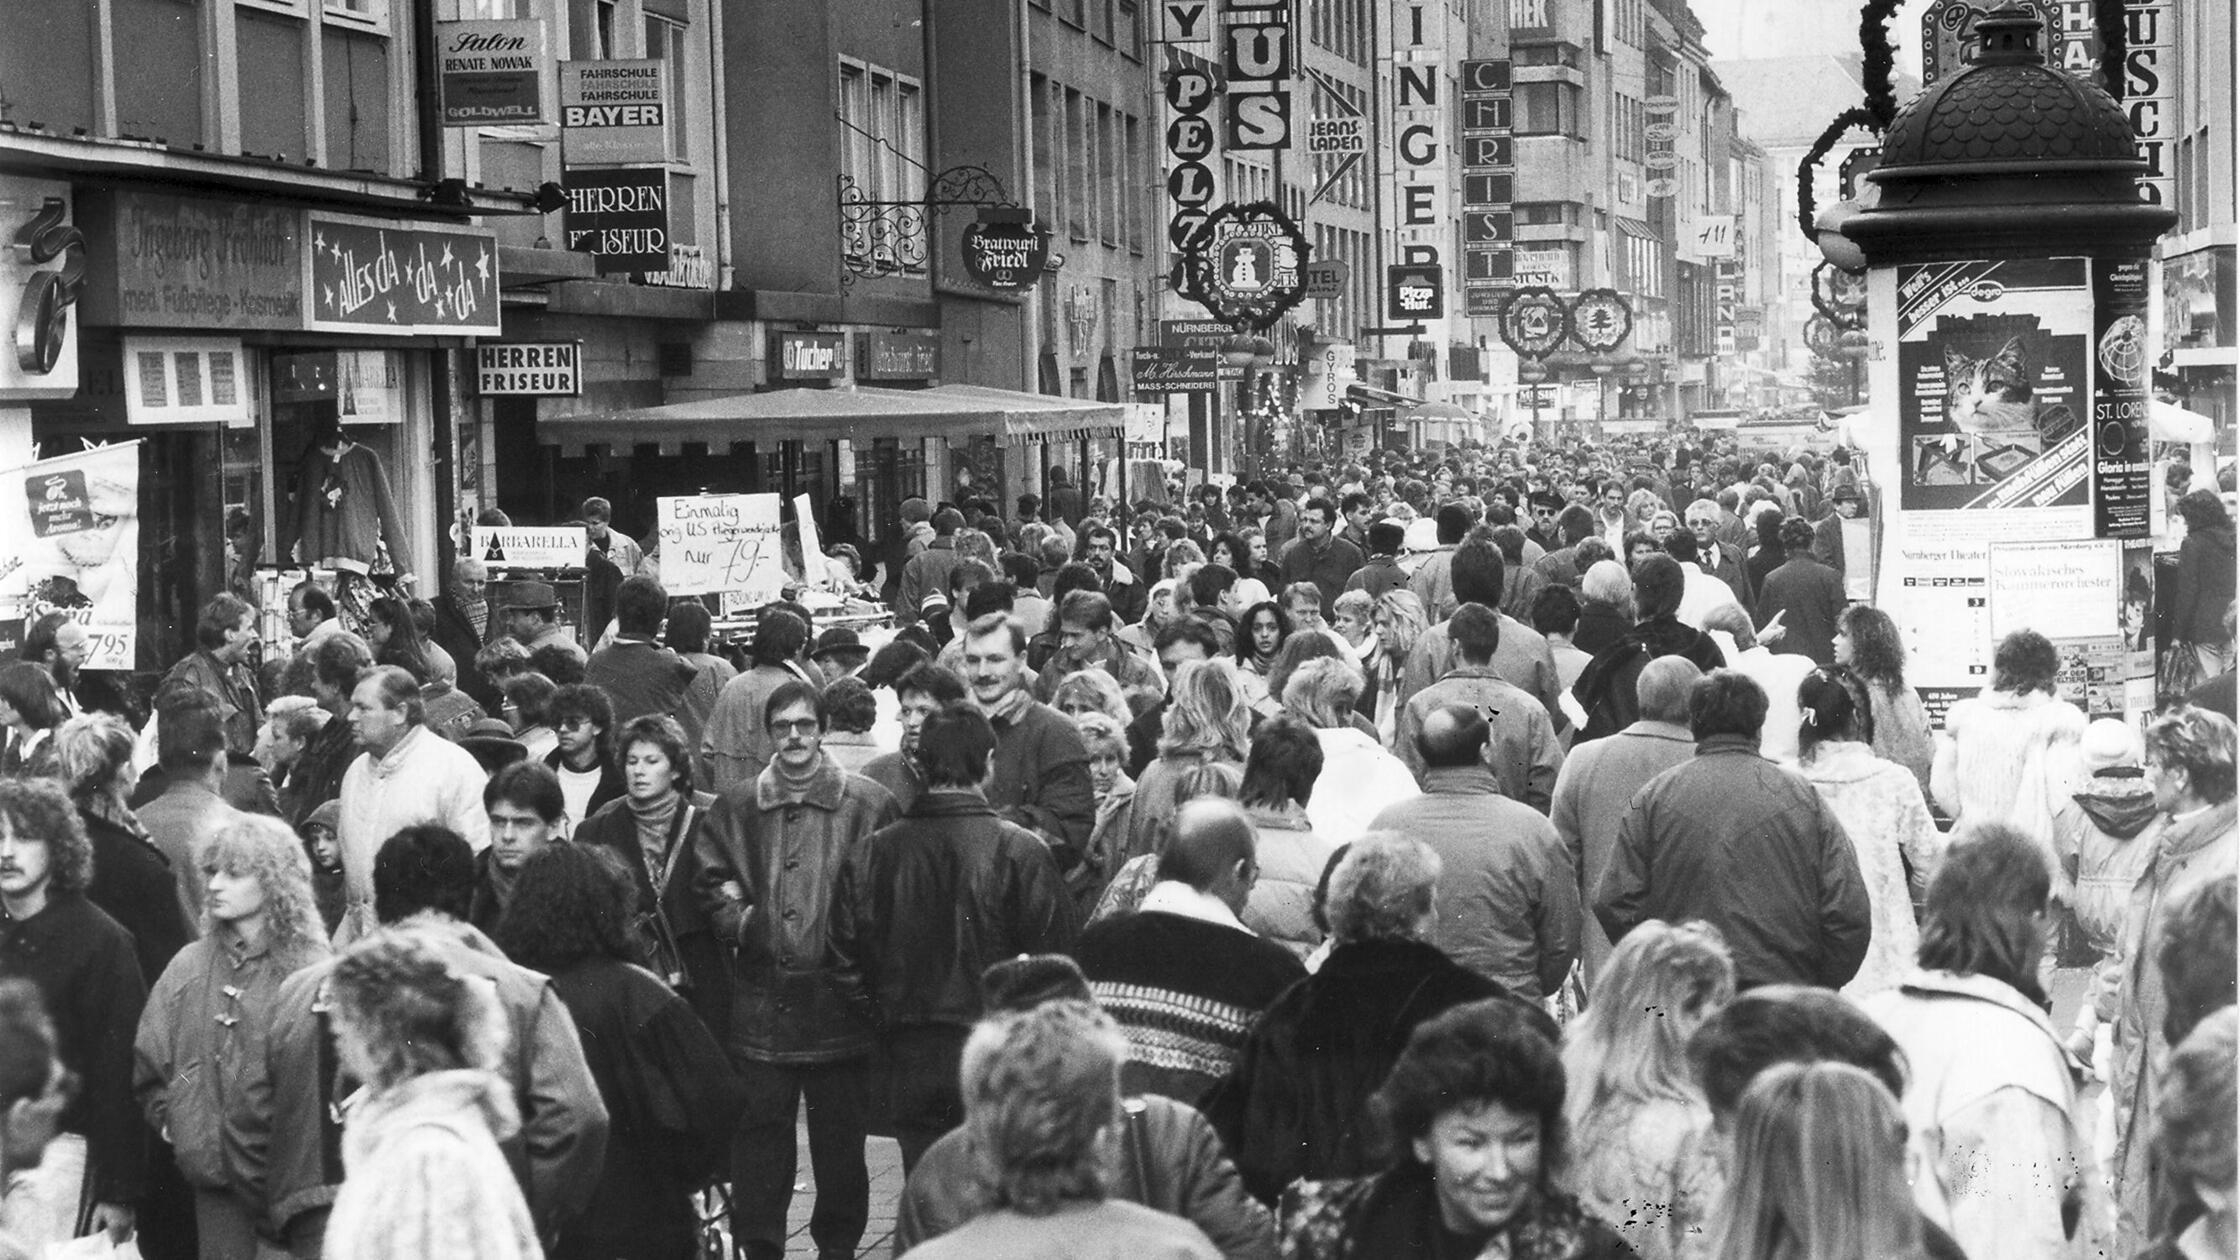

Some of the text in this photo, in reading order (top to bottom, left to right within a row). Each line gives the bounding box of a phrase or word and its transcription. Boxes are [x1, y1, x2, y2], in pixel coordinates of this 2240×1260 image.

[448, 32, 528, 52] Salon
[445, 56, 532, 72] RENATE NOWAK
[580, 68, 658, 79] FAHRSCHULE
[1231, 0, 1286, 145] US
[581, 80, 658, 90] FAHRSCHULE
[581, 90, 658, 101] FAHRSCHULE
[447, 105, 537, 117] GOLDWELL
[566, 105, 660, 126] BAYER
[1309, 136, 1363, 151] LADEN
[1474, 62, 1499, 277] CHRIST
[570, 186, 663, 213] HERREN
[975, 250, 1028, 272] Friedl
[1308, 270, 1340, 284] TEL
[1400, 286, 1434, 300] Pizza
[481, 347, 571, 368] HERREN
[795, 340, 833, 370] Tucher
[482, 373, 571, 390] FRISEUR
[1326, 351, 1336, 404] GYROS
[2097, 403, 2113, 419] ST.
[2097, 460, 2123, 474] Gloria
[674, 499, 740, 527] Einmalig
[686, 522, 707, 536] US
[480, 532, 578, 549] BARBARELLA
[1950, 549, 1987, 560] Theater
